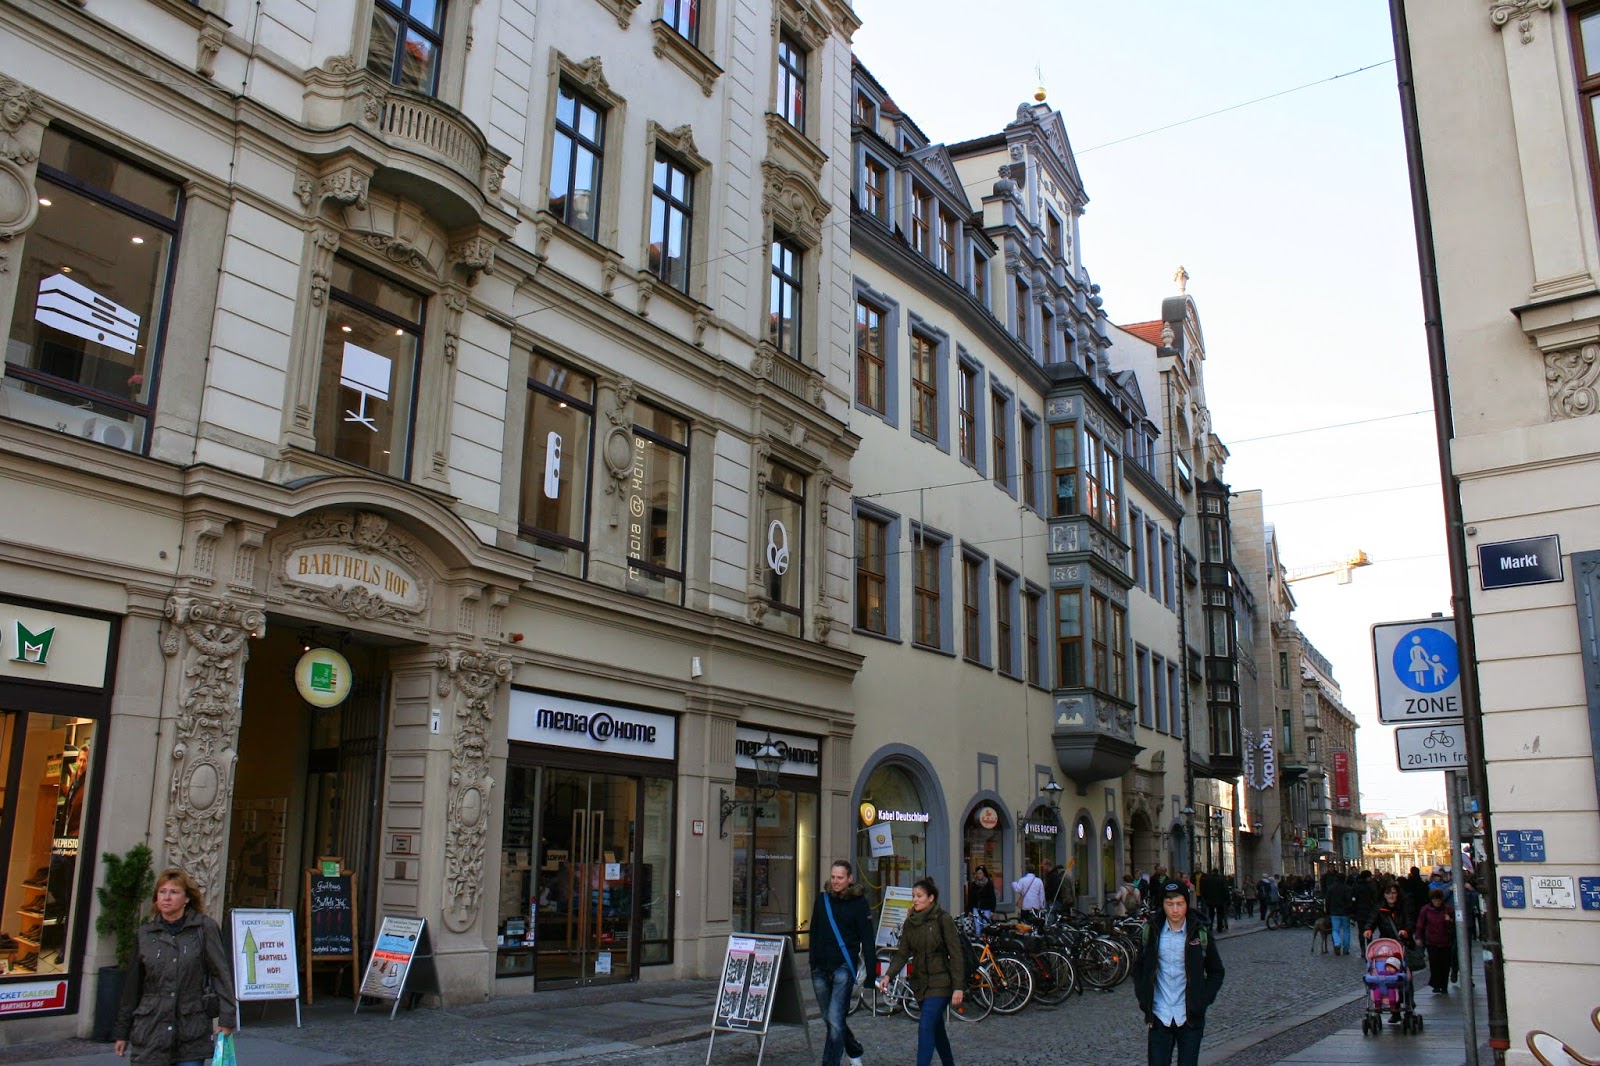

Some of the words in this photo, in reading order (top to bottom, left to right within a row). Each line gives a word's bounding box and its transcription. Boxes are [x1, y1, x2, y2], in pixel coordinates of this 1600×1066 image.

[1500, 554, 1538, 570] Markt
[298, 553, 381, 586] BARTHELS
[384, 569, 410, 599] HOF
[1405, 696, 1458, 714] ZONE
[1408, 753, 1447, 765] 20-11h
[878, 809, 895, 821] Kabel
[896, 811, 929, 823] Deutschland
[1030, 824, 1041, 833] YVES
[1041, 825, 1058, 834] ROCHER
[53, 838, 79, 849] MEPHISTO
[260, 941, 275, 950] JETZT
[31, 1000, 45, 1008] HOF
